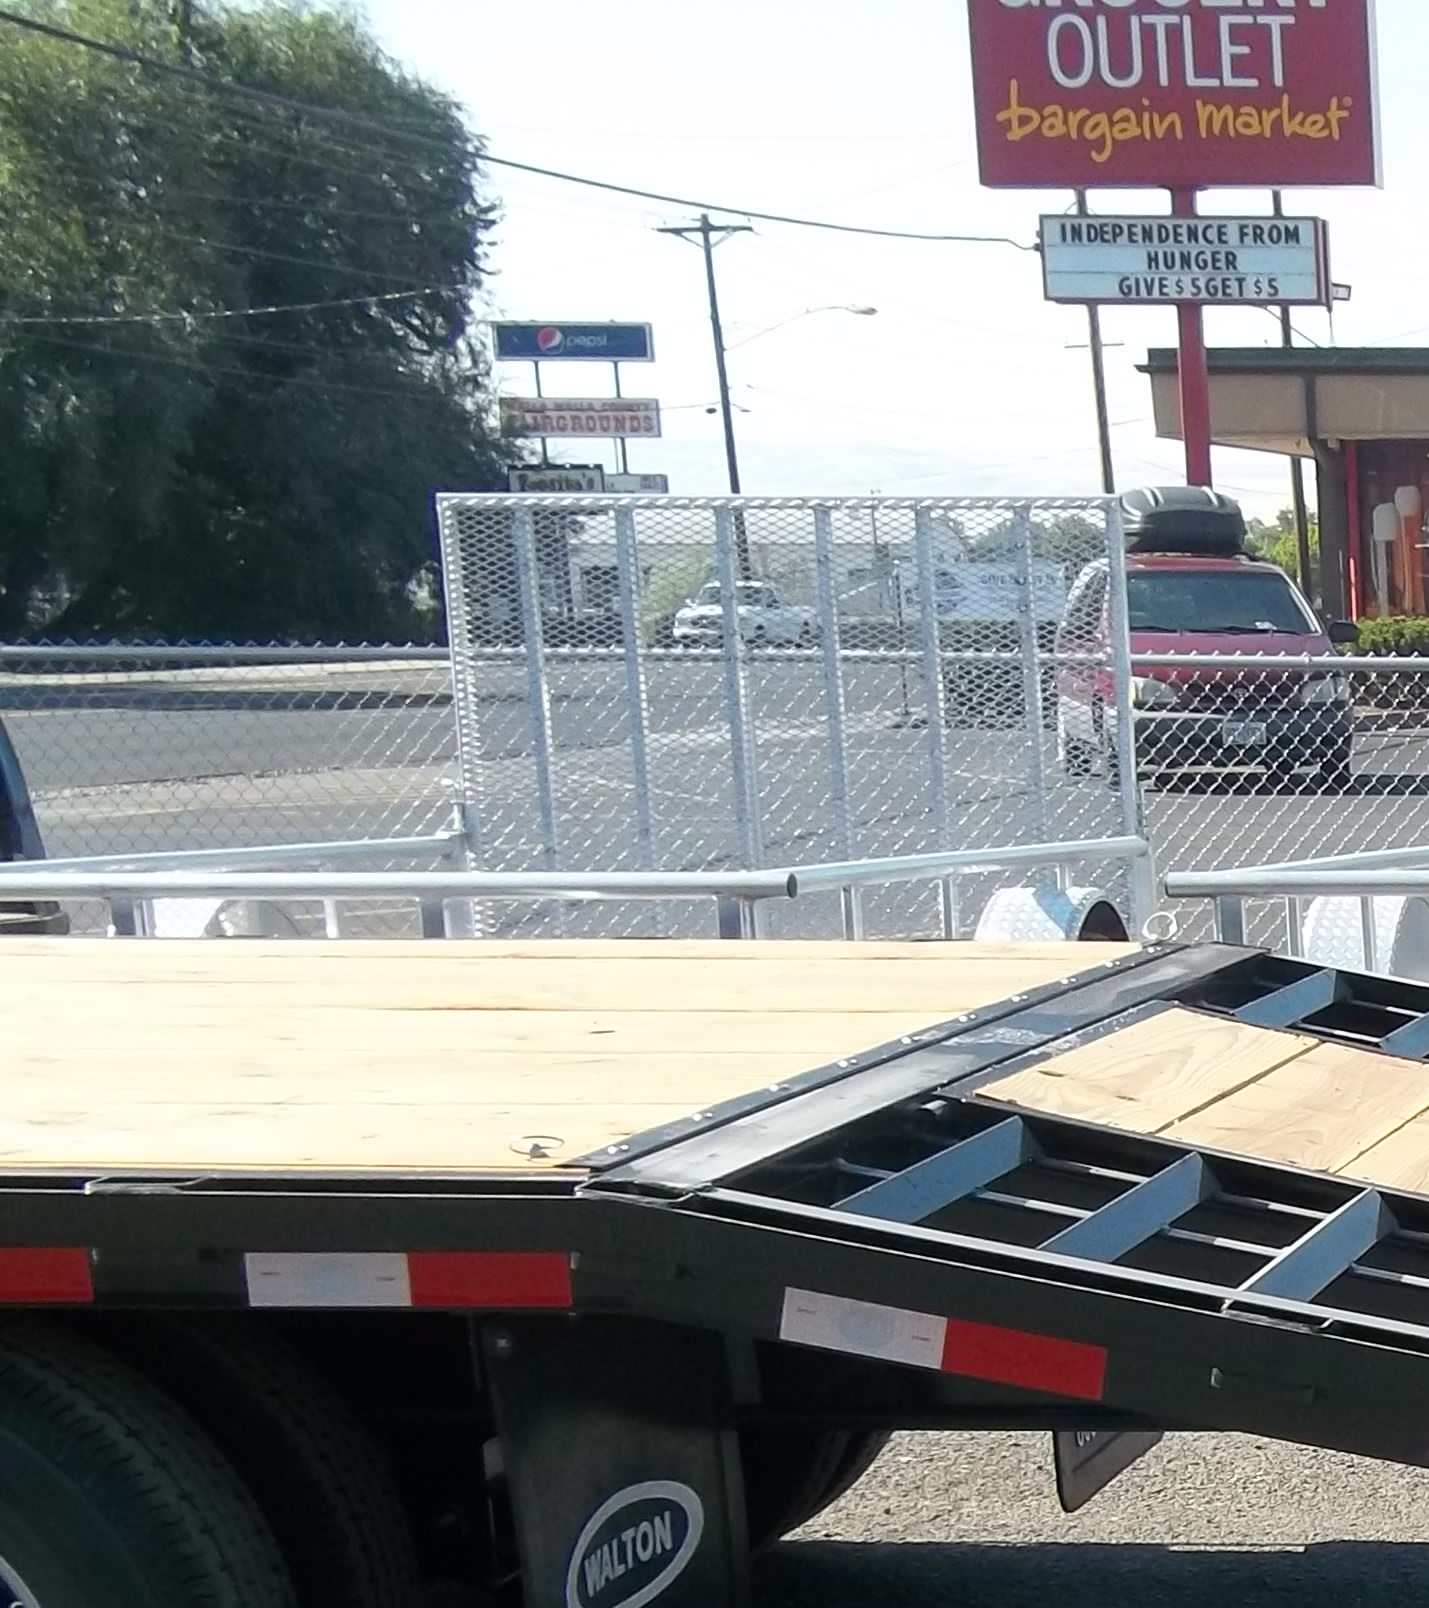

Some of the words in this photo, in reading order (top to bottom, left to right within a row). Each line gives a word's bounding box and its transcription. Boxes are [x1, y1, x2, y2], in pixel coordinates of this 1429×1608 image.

[1047, 13, 1295, 88] OUTLET
[996, 78, 1183, 162] bargain
[1197, 93, 1346, 142] market
[1060, 223, 1228, 244] INDEPENDENCE
[1239, 224, 1300, 245] FROM
[1147, 250, 1238, 271] HUNGER
[566, 335, 607, 347] pepsi
[584, 1511, 673, 1598] WALTON
